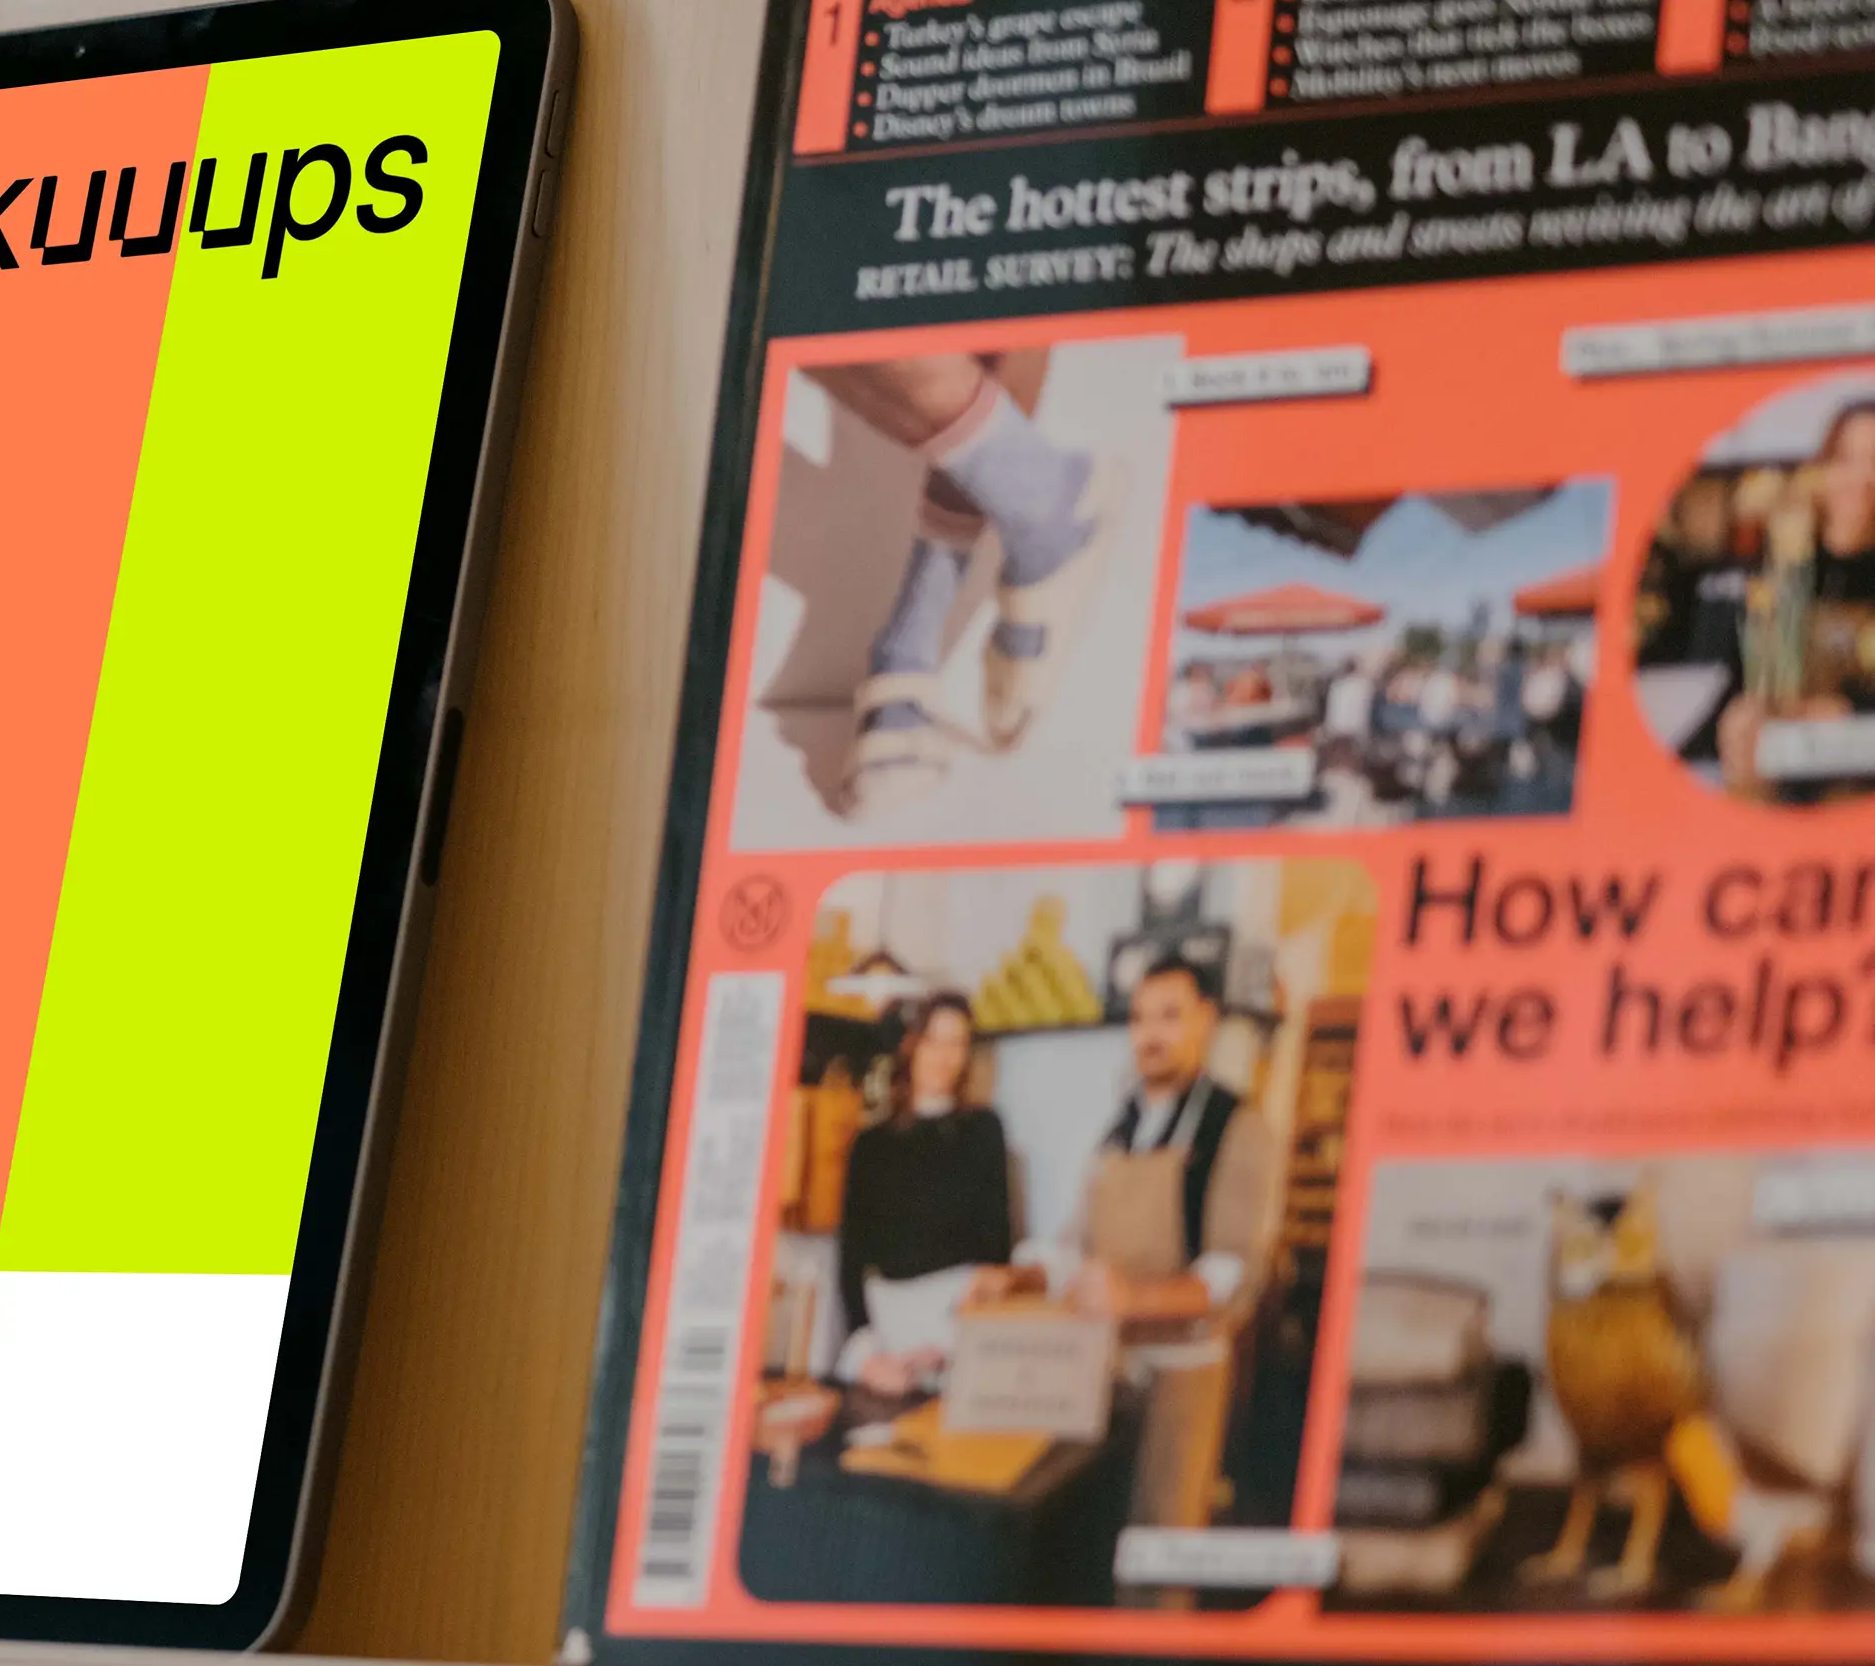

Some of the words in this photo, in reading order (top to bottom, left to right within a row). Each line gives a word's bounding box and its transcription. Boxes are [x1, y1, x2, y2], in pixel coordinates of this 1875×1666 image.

[823, 0, 844, 48] 1
[879, 46, 960, 80] Sound
[962, 42, 1025, 72] ideas
[1027, 35, 1089, 66] from
[885, 181, 997, 241] The
[1005, 174, 1195, 232] hottest
[1203, 147, 1376, 222] strips,
[1389, 135, 1534, 202] from
[1544, 115, 1654, 189] LA
[1667, 122, 1732, 178] to
[855, 257, 978, 300] RETAIL
[985, 244, 1134, 289] SURVEY:
[1145, 230, 1219, 277] The
[1221, 222, 1324, 277] shops
[1326, 210, 1409, 264] and
[1400, 852, 1662, 947] How
[1399, 981, 1558, 1060] we
